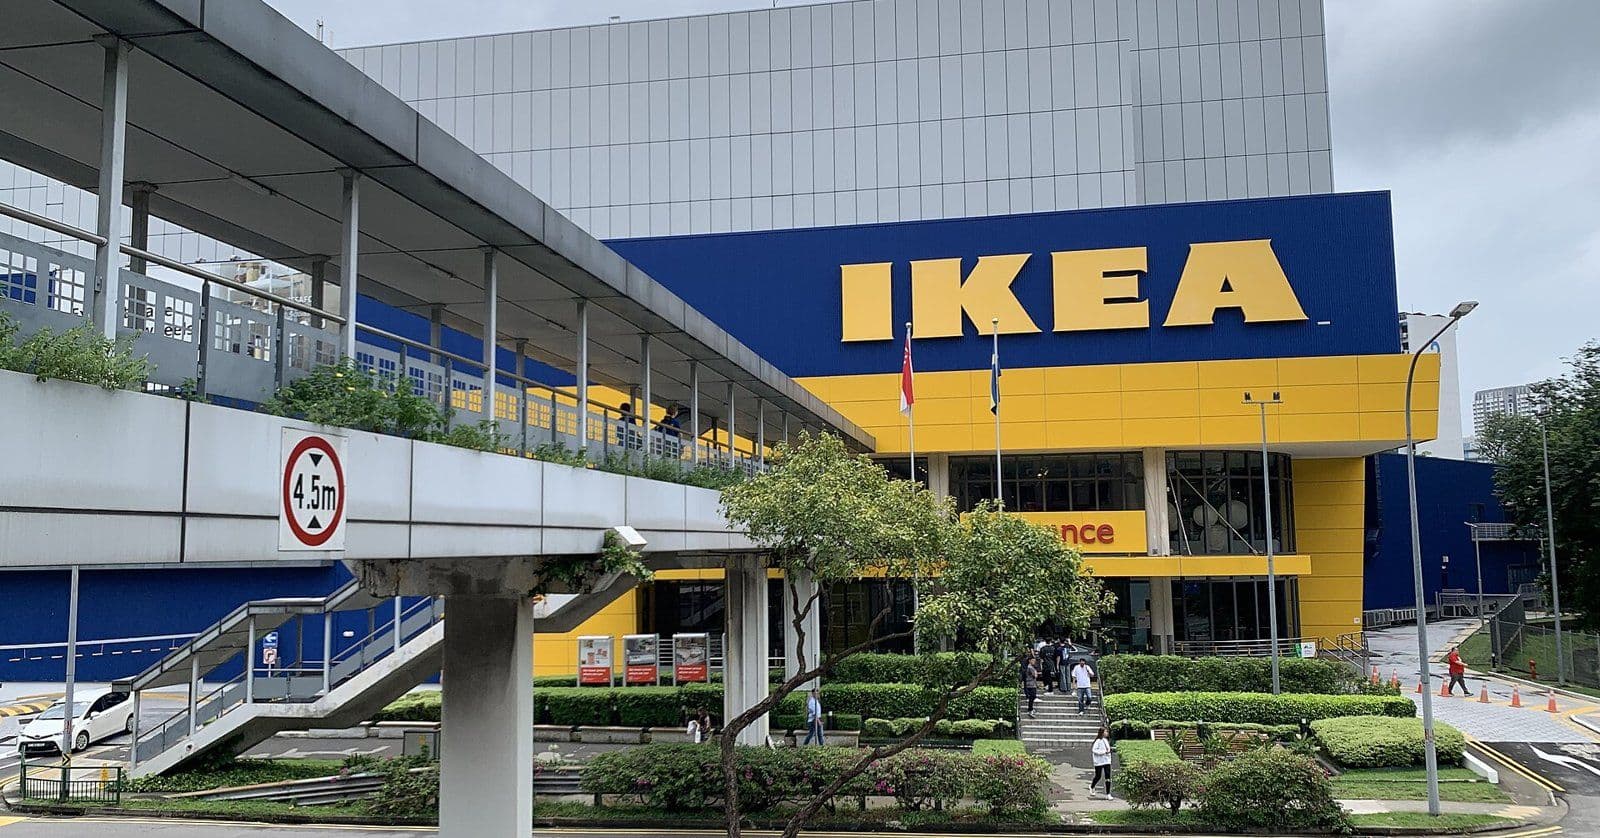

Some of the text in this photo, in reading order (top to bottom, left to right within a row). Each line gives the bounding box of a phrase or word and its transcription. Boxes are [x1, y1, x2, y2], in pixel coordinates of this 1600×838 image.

[840, 239, 1309, 342] IKEA
[293, 472, 336, 511] 4.5m
[1057, 523, 1115, 545] nce
